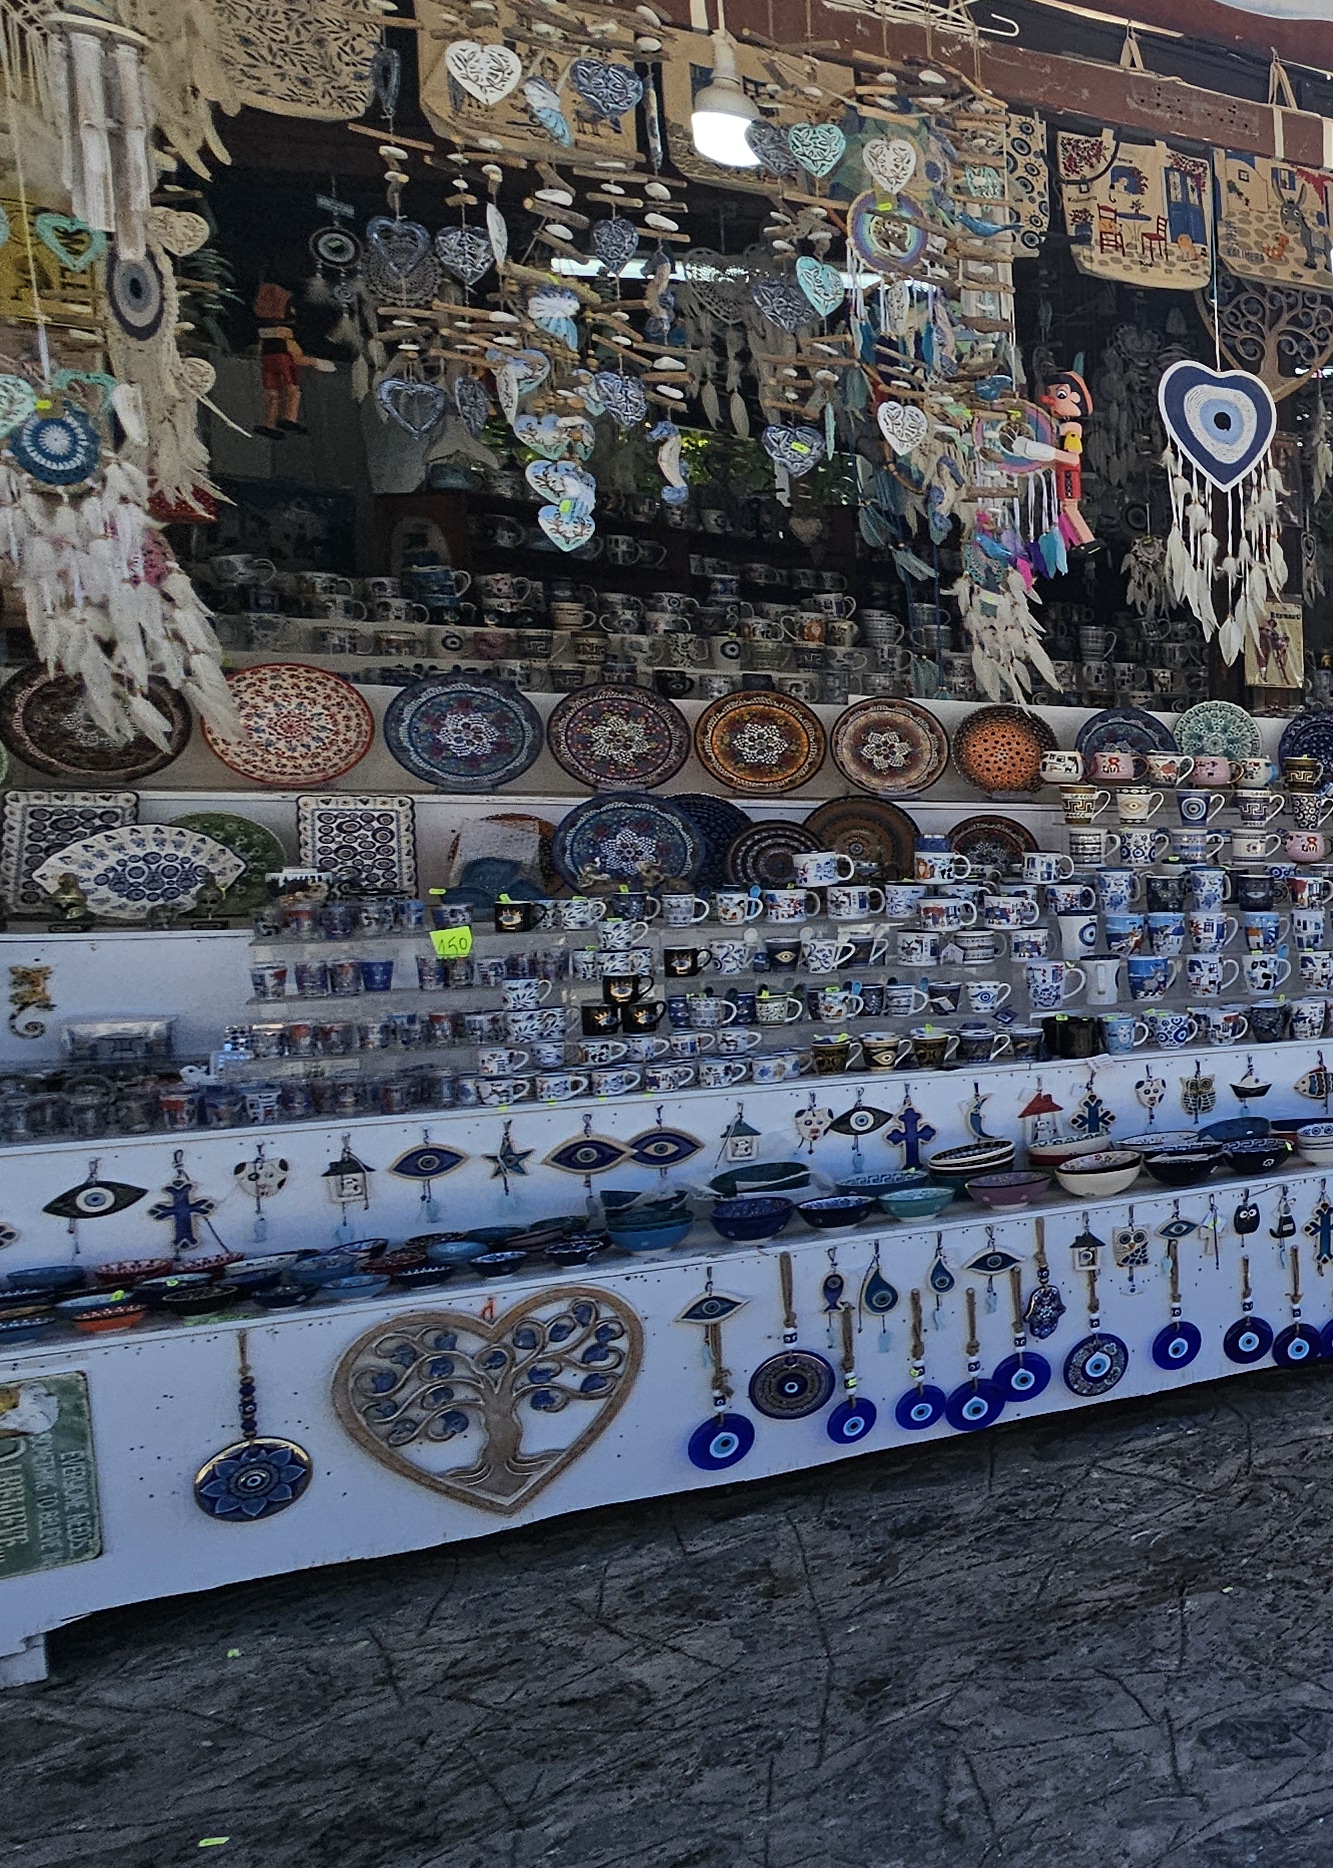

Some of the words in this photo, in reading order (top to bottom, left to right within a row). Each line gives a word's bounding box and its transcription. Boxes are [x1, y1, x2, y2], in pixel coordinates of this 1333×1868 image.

[36, 1492, 59, 1508] TO
[60, 1450, 89, 1512] EVERYONE
[38, 1510, 63, 1550] BELIEVE
